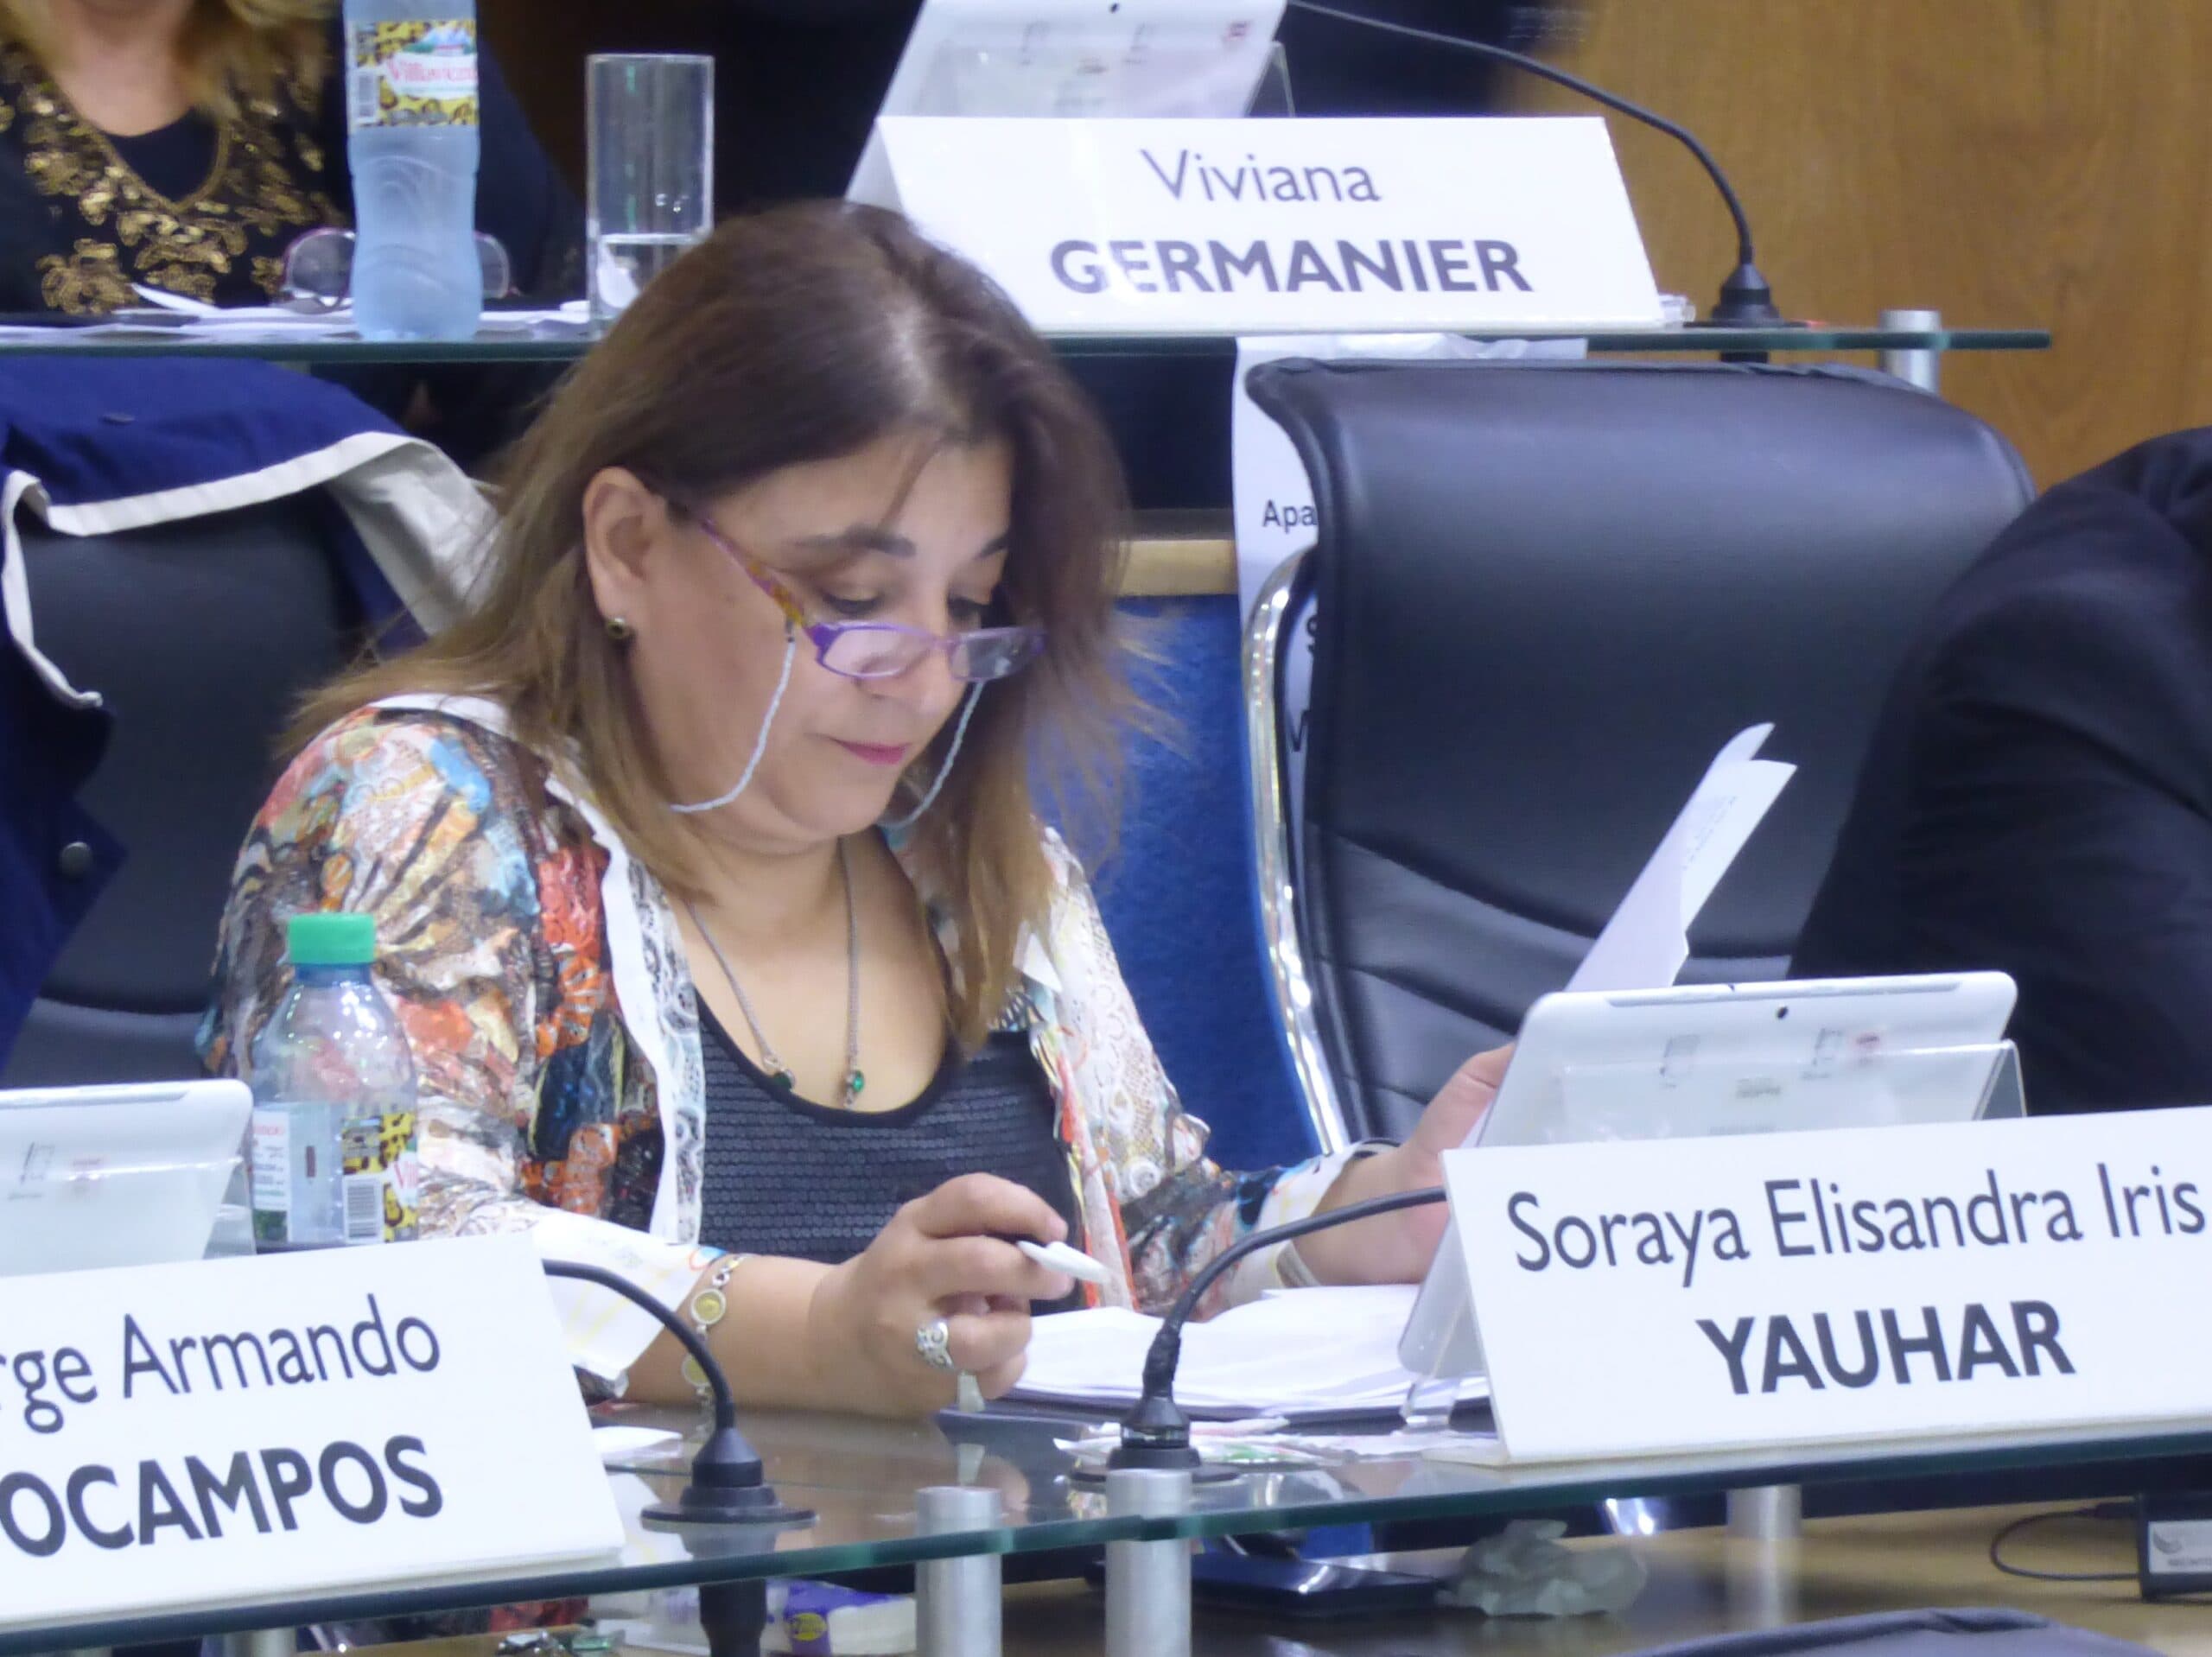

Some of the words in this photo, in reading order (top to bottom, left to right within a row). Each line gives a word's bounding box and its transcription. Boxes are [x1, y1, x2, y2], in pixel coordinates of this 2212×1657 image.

[1141, 149, 1382, 203] Viviana
[1050, 239, 1534, 295] GERMANIER
[1507, 1190, 1751, 1289] Soraya
[1764, 1168, 2084, 1258] Elisandra
[2096, 1162, 2206, 1238] Iris
[0, 1347, 99, 1434] ge
[123, 1292, 441, 1400] Armando
[1694, 1299, 2076, 1395] YAUHAR
[0, 1434, 443, 1558] OCAMPOS
